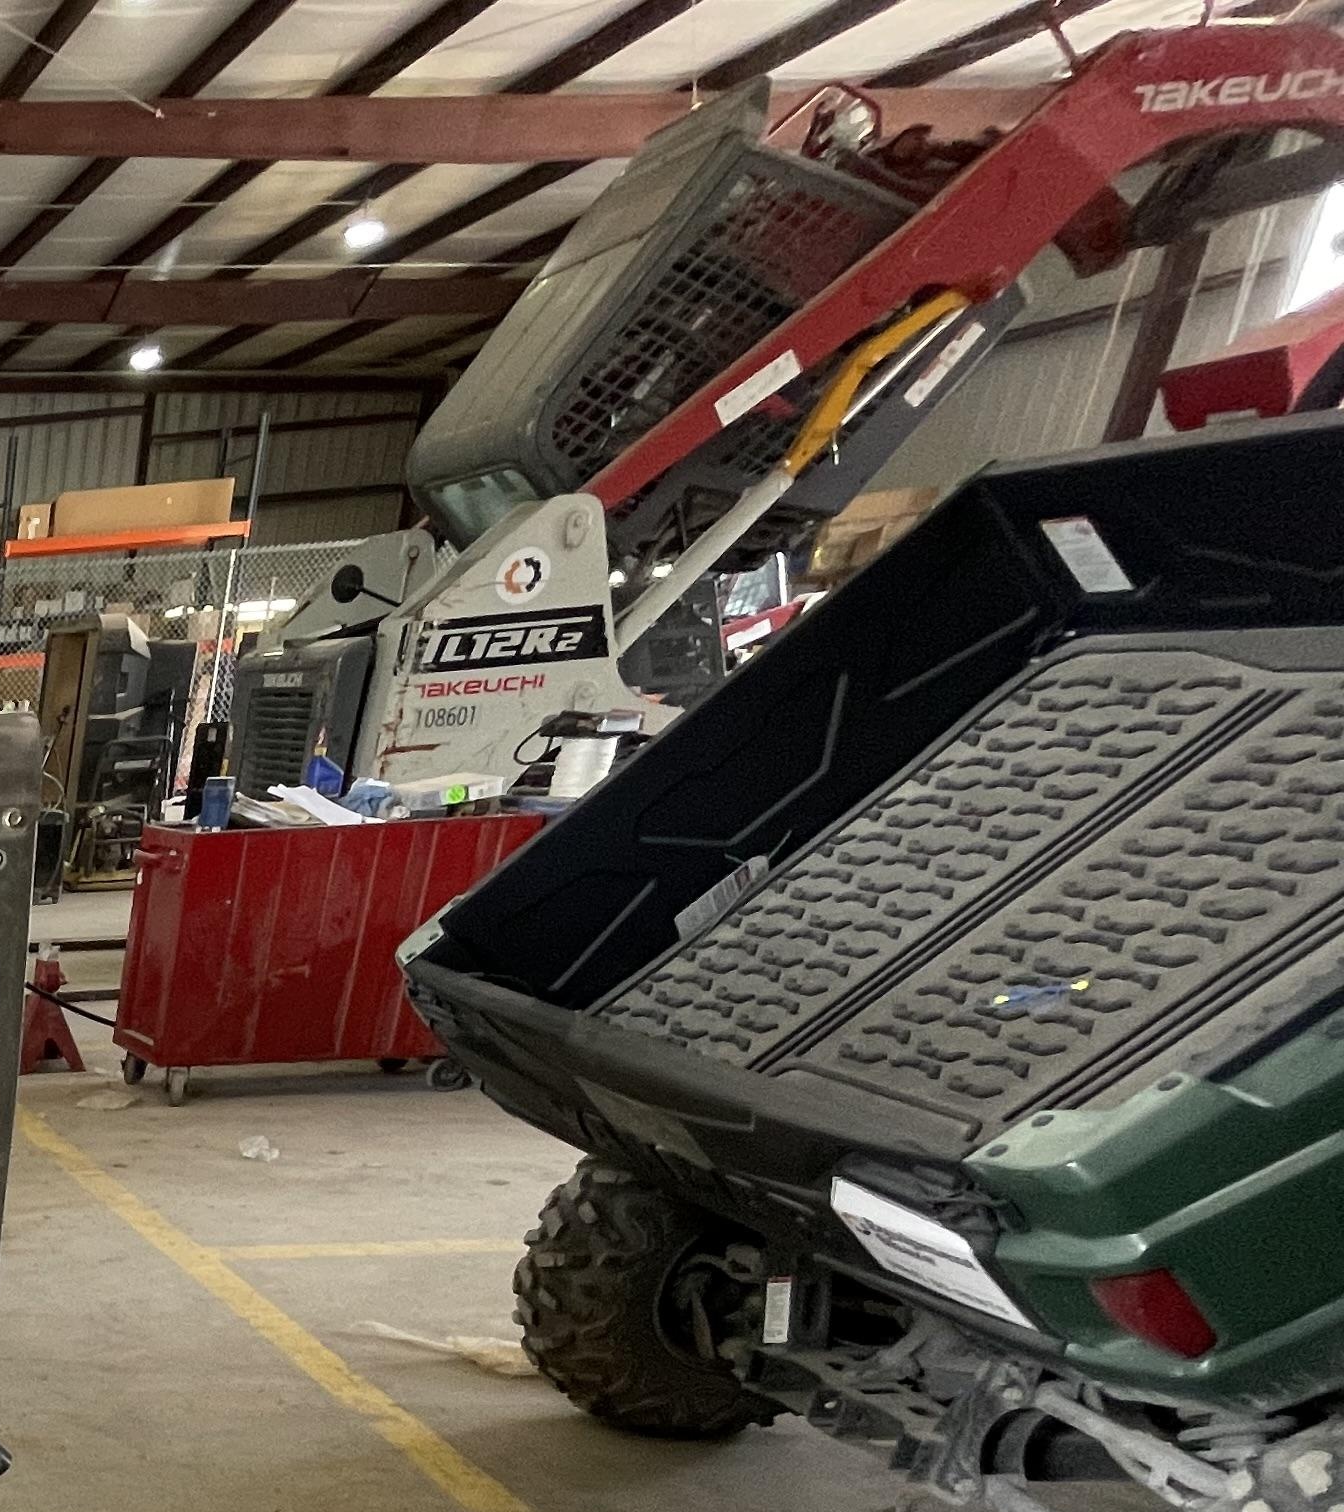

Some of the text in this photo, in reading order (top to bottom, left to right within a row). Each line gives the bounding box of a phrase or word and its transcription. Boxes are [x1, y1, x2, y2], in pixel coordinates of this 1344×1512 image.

[1132, 67, 1344, 113] TAKEUCH
[414, 673, 546, 698] TAKEUCHI
[416, 705, 476, 727] 108601
